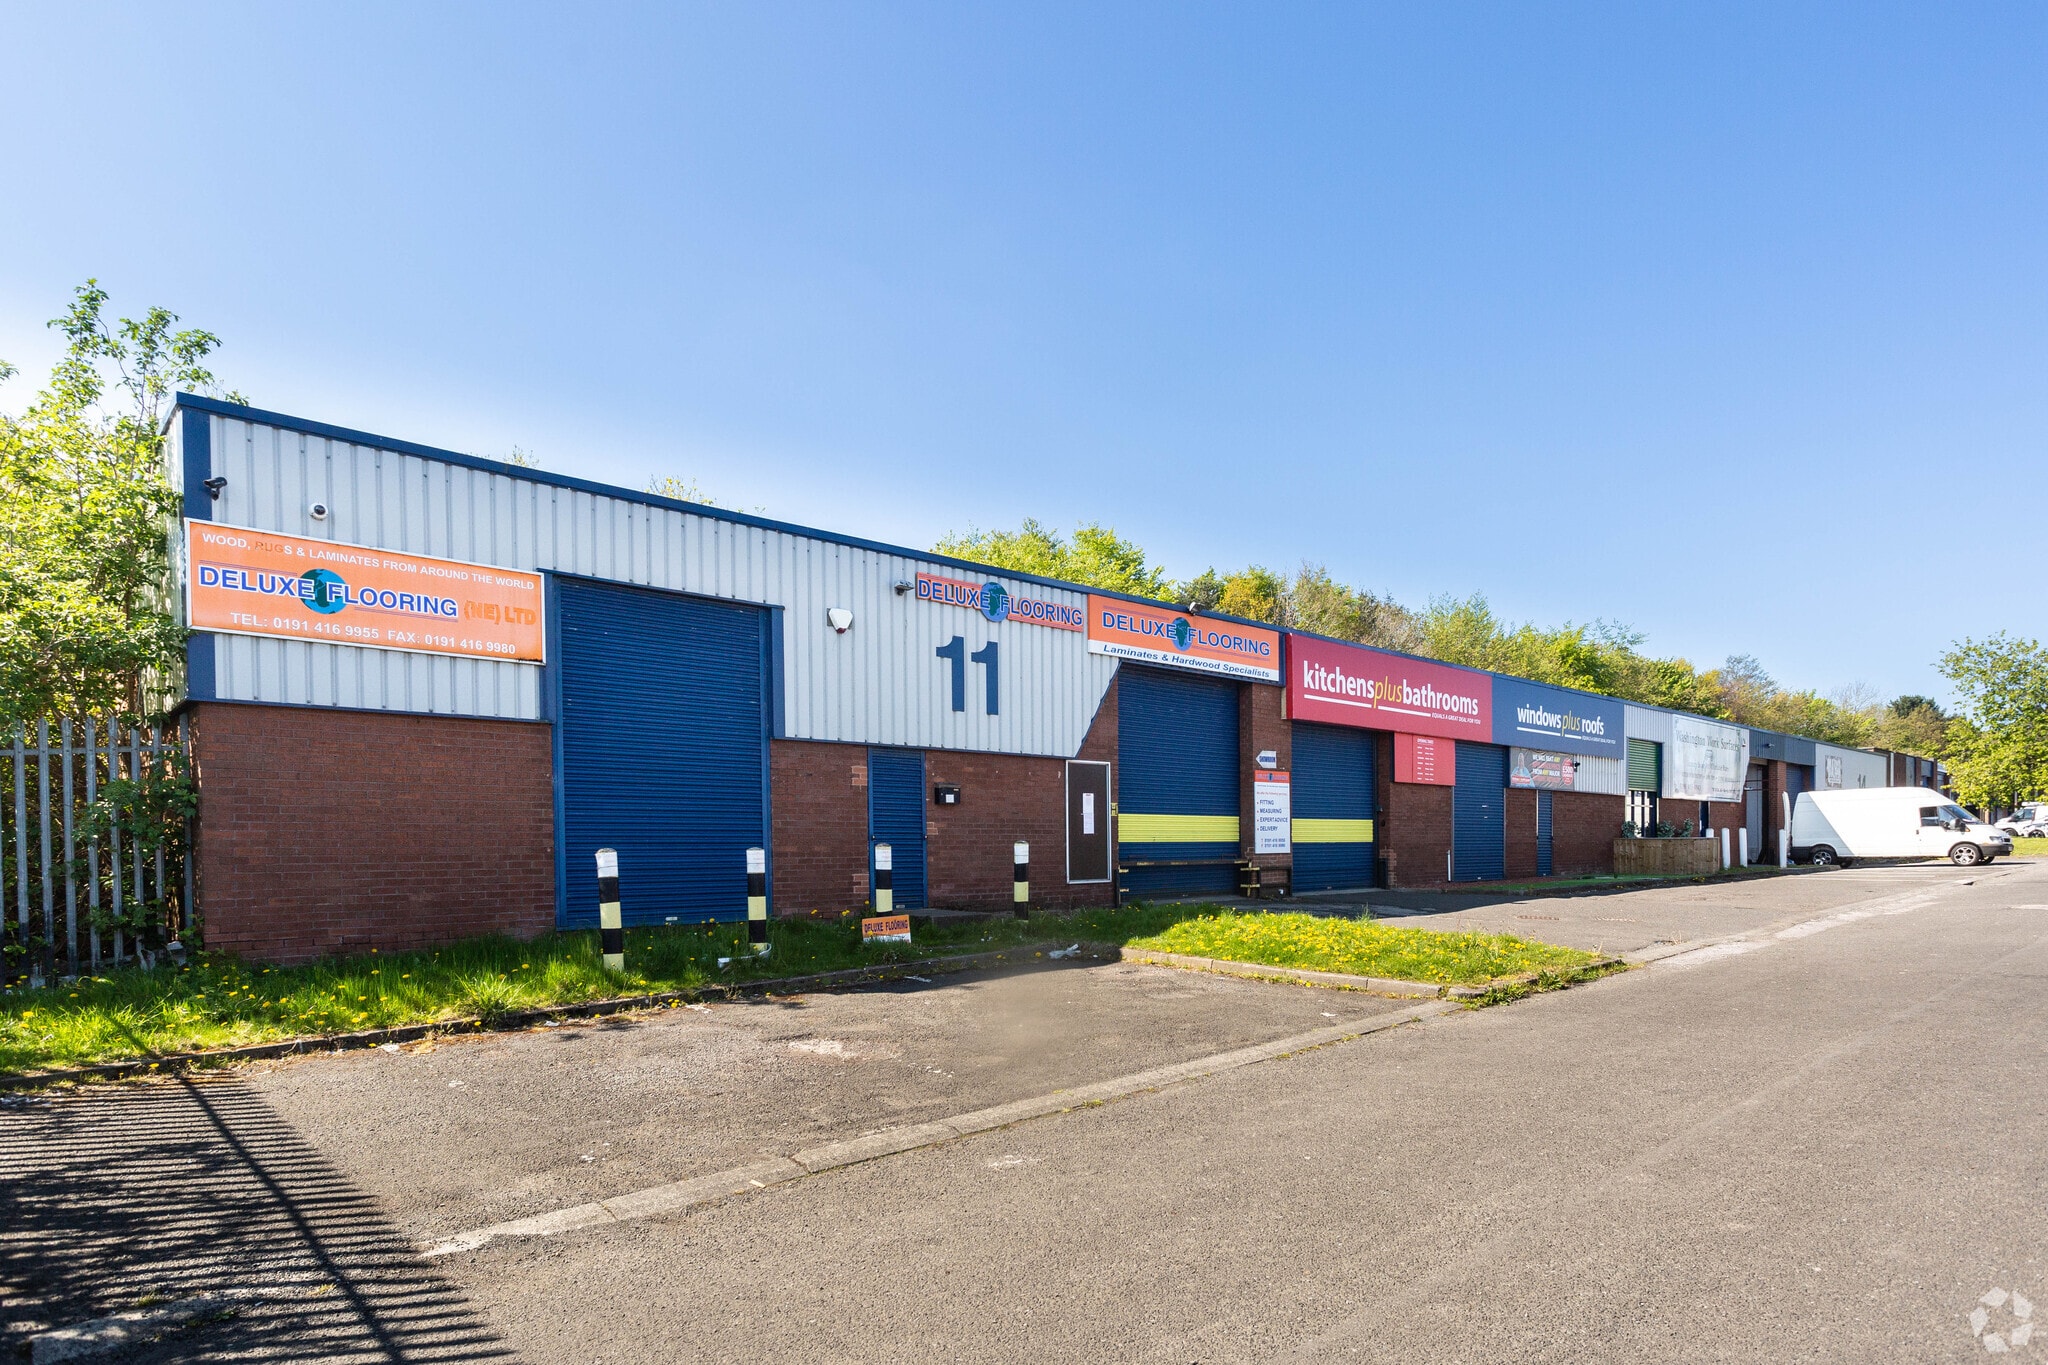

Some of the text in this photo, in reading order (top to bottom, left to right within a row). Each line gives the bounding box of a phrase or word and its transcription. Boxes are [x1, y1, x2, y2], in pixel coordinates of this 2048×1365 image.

[202, 533, 250, 550] WOOD,
[297, 548, 305, 557] &
[309, 549, 380, 568] LAMINATES
[383, 560, 417, 573] FROM
[420, 565, 469, 581] AROUND
[471, 573, 493, 584] THE
[495, 577, 535, 590] WORLD
[198, 565, 315, 600] DELUXE
[326, 580, 459, 617] FLOORING
[504, 606, 537, 625] LTD
[918, 579, 1083, 626] DELUXE FLOORING
[230, 612, 516, 654] TEL: 0191 416 9955 FAX: 0191 416 9980
[1102, 611, 1271, 656] DELUXE FLOORING
[936, 635, 999, 716] 11
[1103, 644, 1270, 678] Laminates & Hardwood Specialists
[864, 920, 908, 933] DELUXE FLOORING
